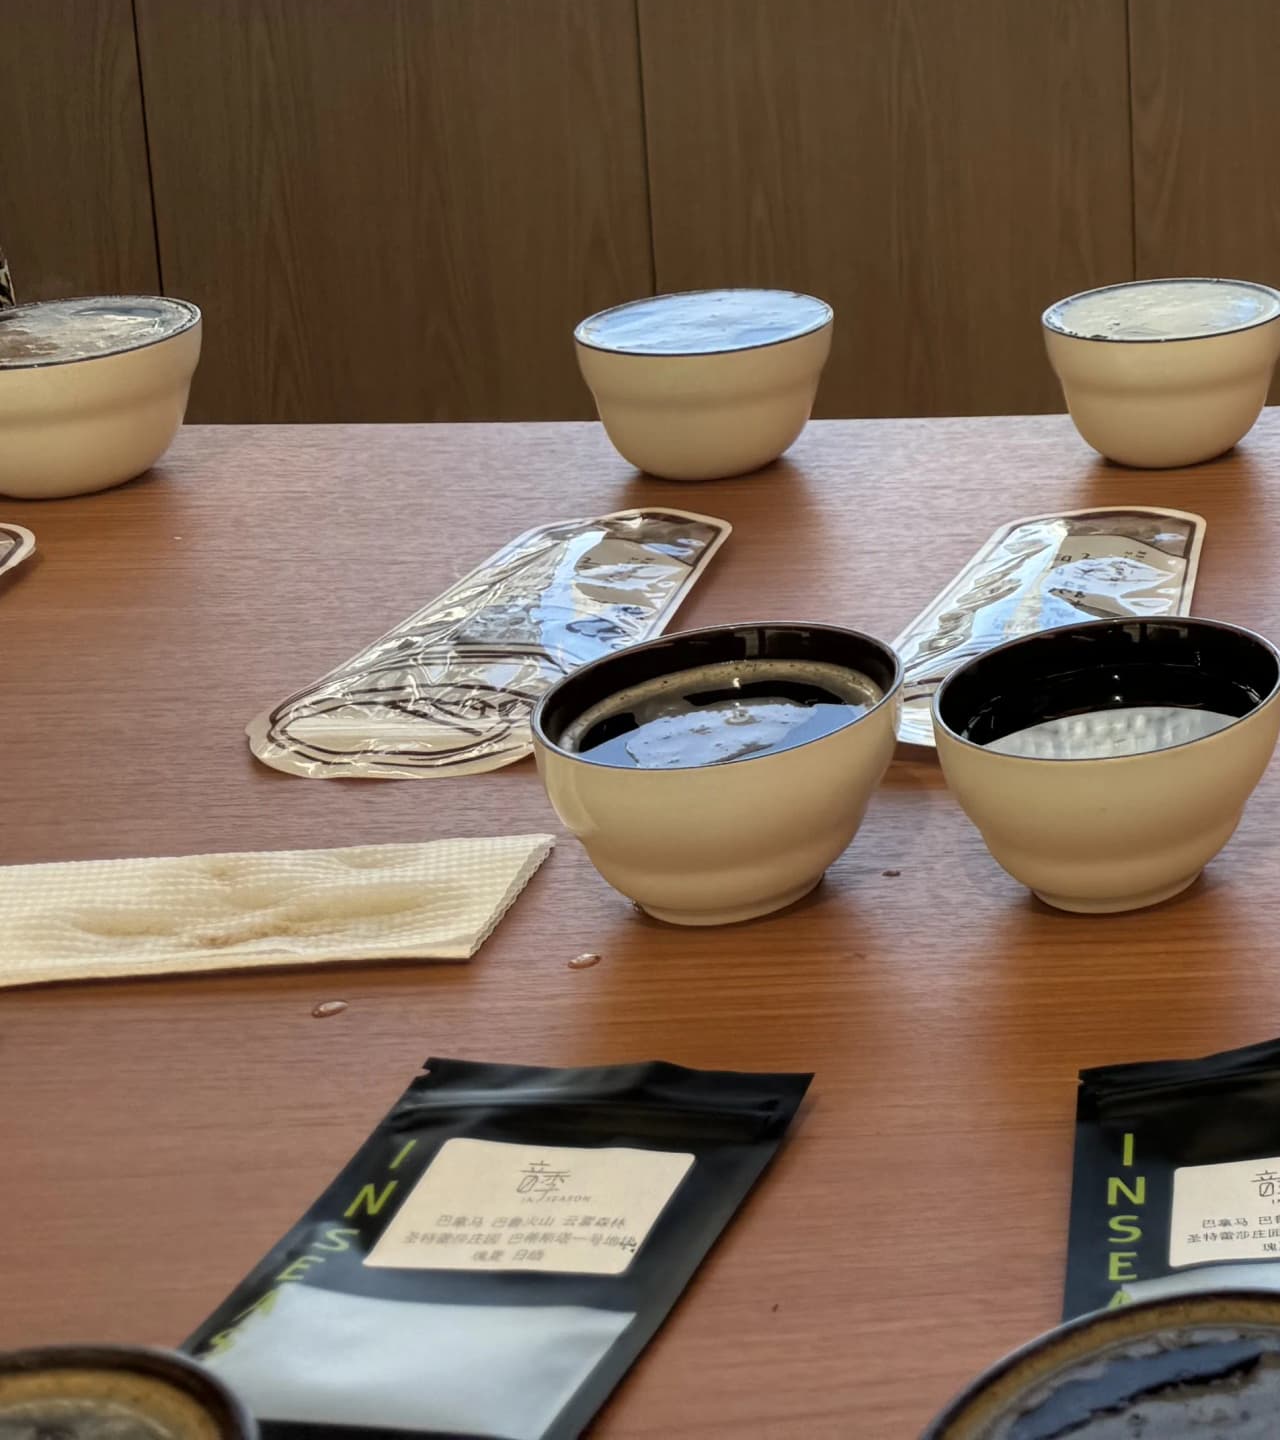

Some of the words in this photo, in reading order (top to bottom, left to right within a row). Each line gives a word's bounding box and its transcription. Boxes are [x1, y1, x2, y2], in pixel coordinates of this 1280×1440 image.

[435, 1214, 484, 1229] 巴拿马
[491, 1214, 554, 1229] 巴鲁火山
[1201, 1216, 1249, 1229] 巴拿马
